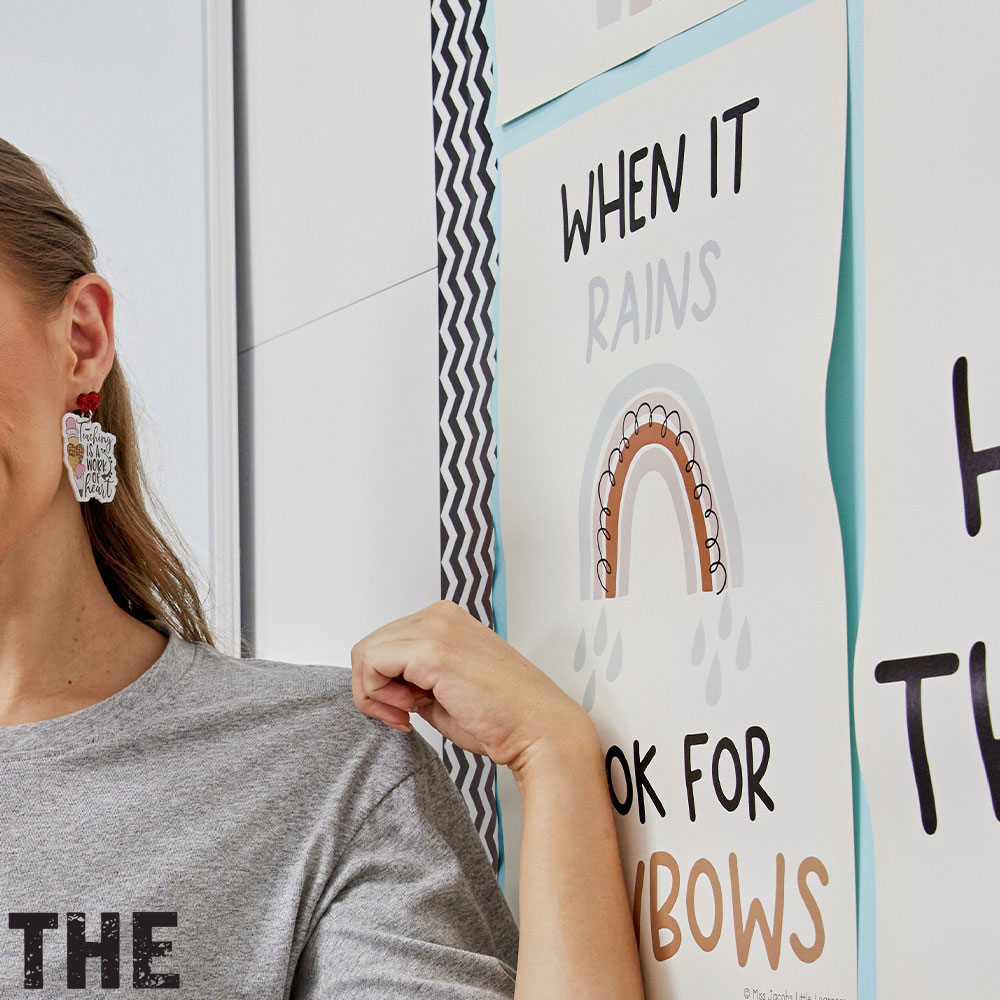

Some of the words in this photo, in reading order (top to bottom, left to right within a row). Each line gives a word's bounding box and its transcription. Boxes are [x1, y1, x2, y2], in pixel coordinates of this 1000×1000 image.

[561, 134, 686, 263] WHEN
[710, 97, 760, 199] IT
[586, 240, 721, 364] RAINS
[86, 445, 93, 457] IS
[95, 446, 101, 458] A
[86, 459, 107, 472] WORK
[85, 474, 114, 498] heart
[91, 472, 101, 484] OF
[605, 740, 666, 824] OK
[683, 725, 774, 822] FOR
[8, 911, 180, 989] THE
[752, 988, 766, 1000] Miss
